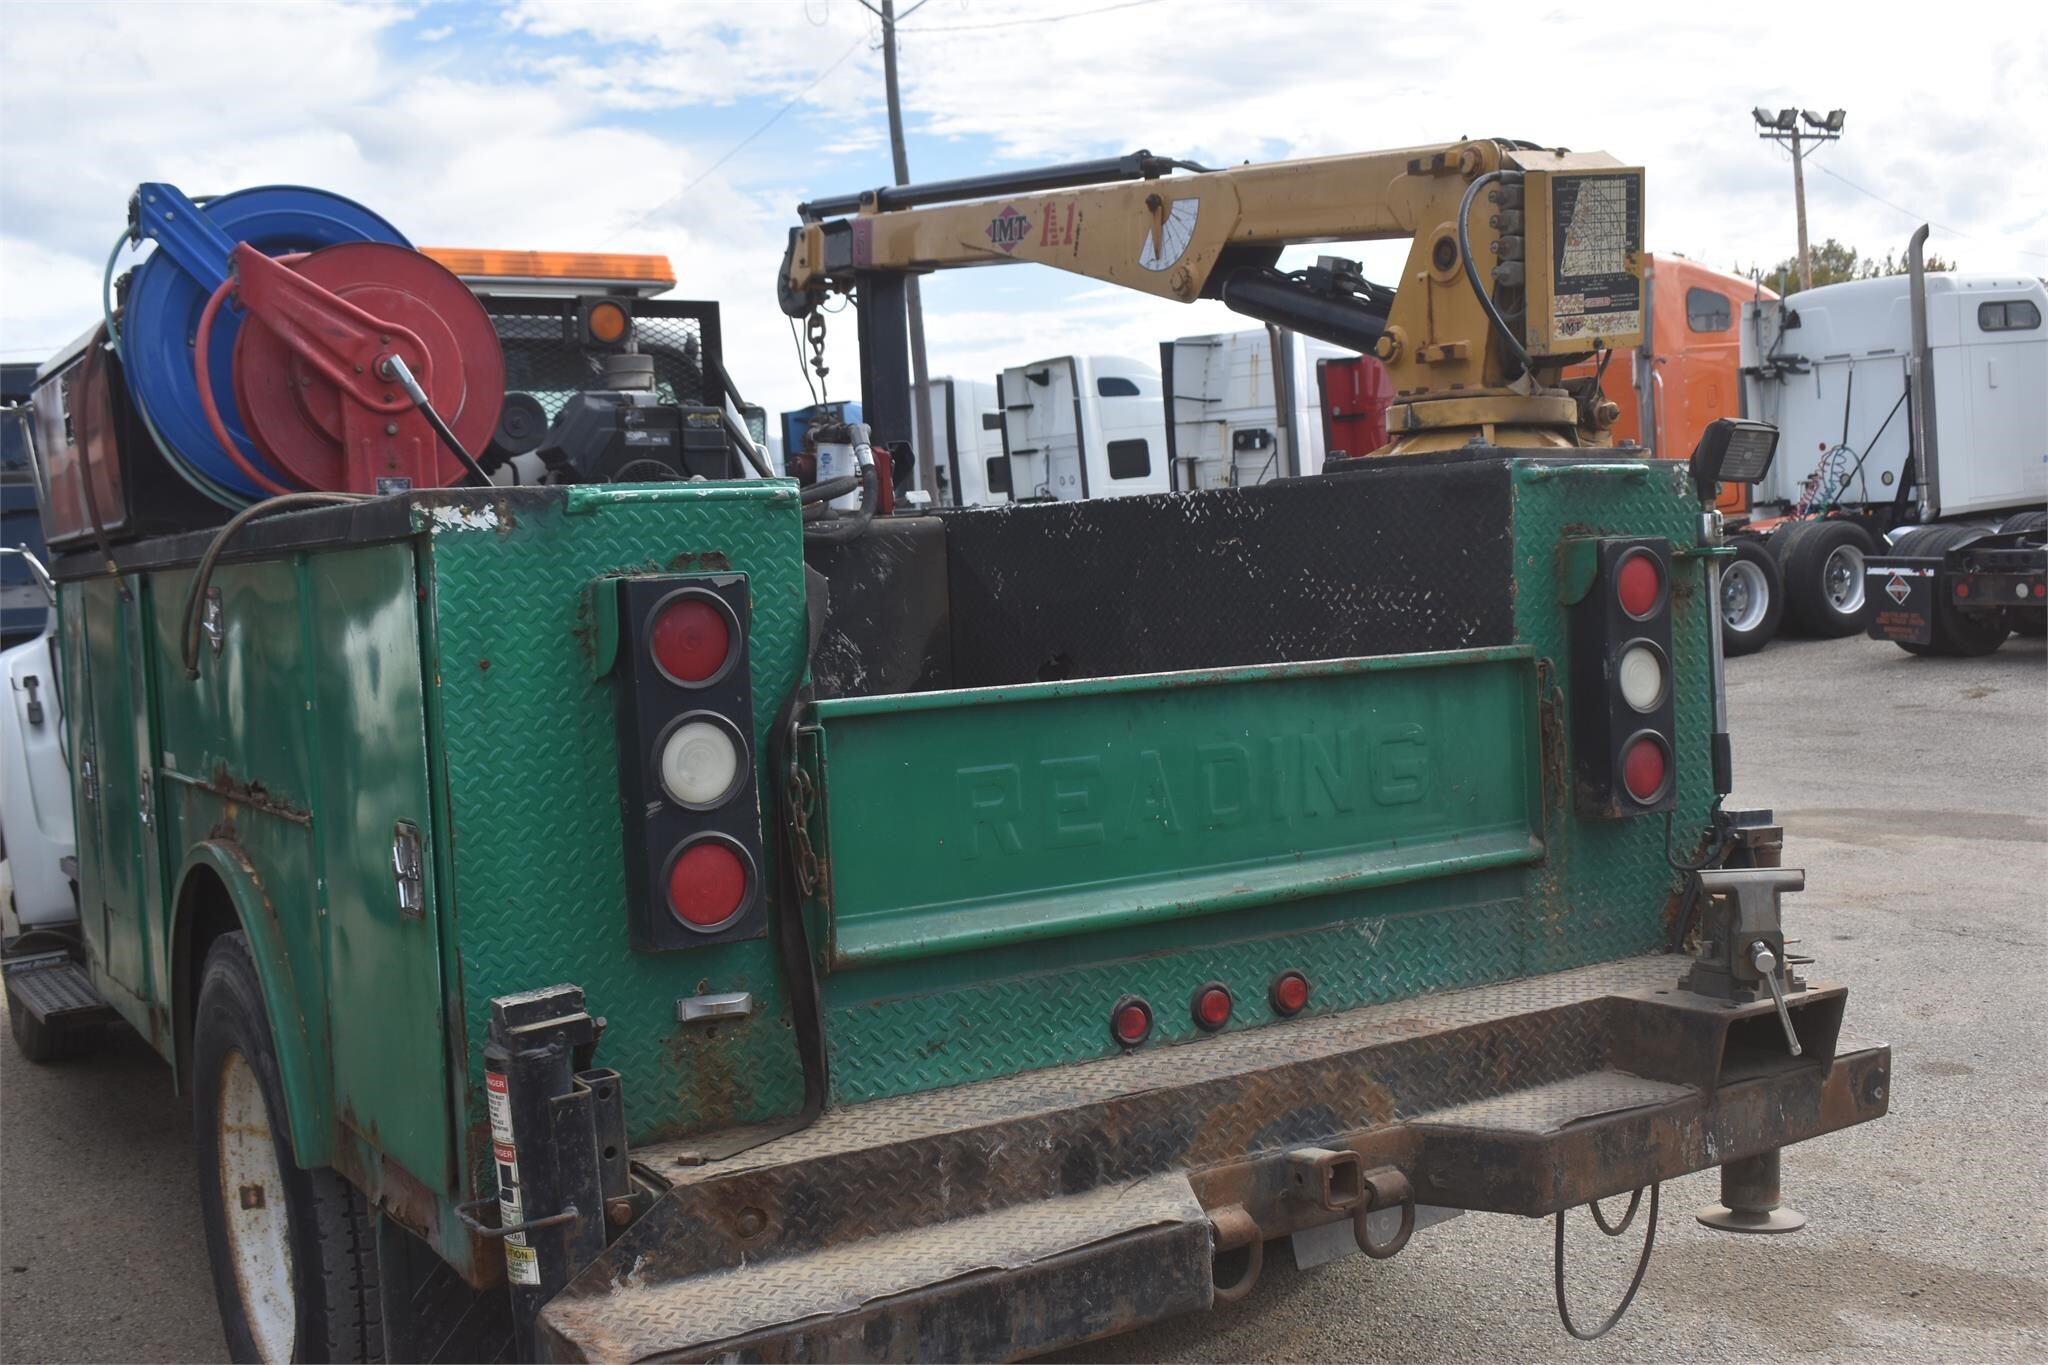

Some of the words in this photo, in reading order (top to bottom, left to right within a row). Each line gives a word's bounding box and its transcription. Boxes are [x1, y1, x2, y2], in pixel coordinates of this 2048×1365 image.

[991, 216, 1027, 243] IMT
[956, 721, 1434, 861] READING
[488, 1080, 504, 1088] NGER
[496, 1150, 512, 1158] NGER
[509, 1249, 528, 1260] TION
